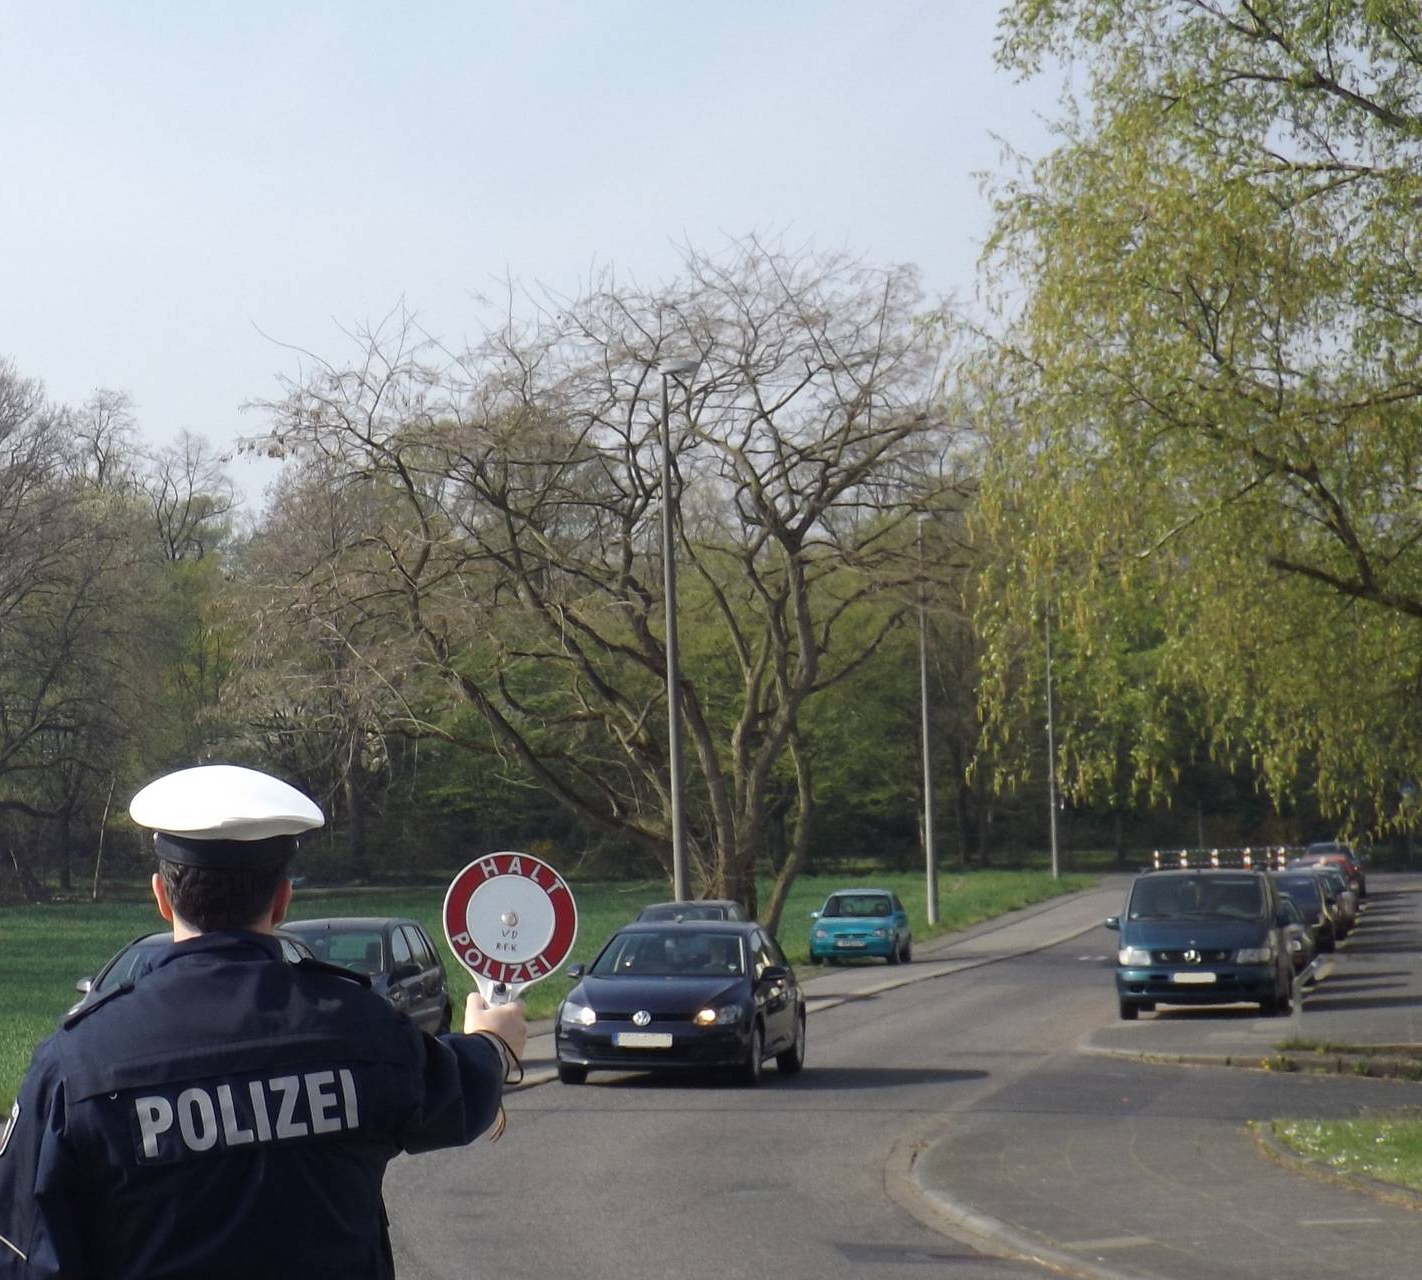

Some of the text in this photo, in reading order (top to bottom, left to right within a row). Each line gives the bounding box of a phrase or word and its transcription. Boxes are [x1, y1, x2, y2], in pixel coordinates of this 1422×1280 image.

[480, 857, 563, 895] HALT
[451, 932, 552, 983] POLIZEI
[136, 1069, 359, 1157] POLIZEI
